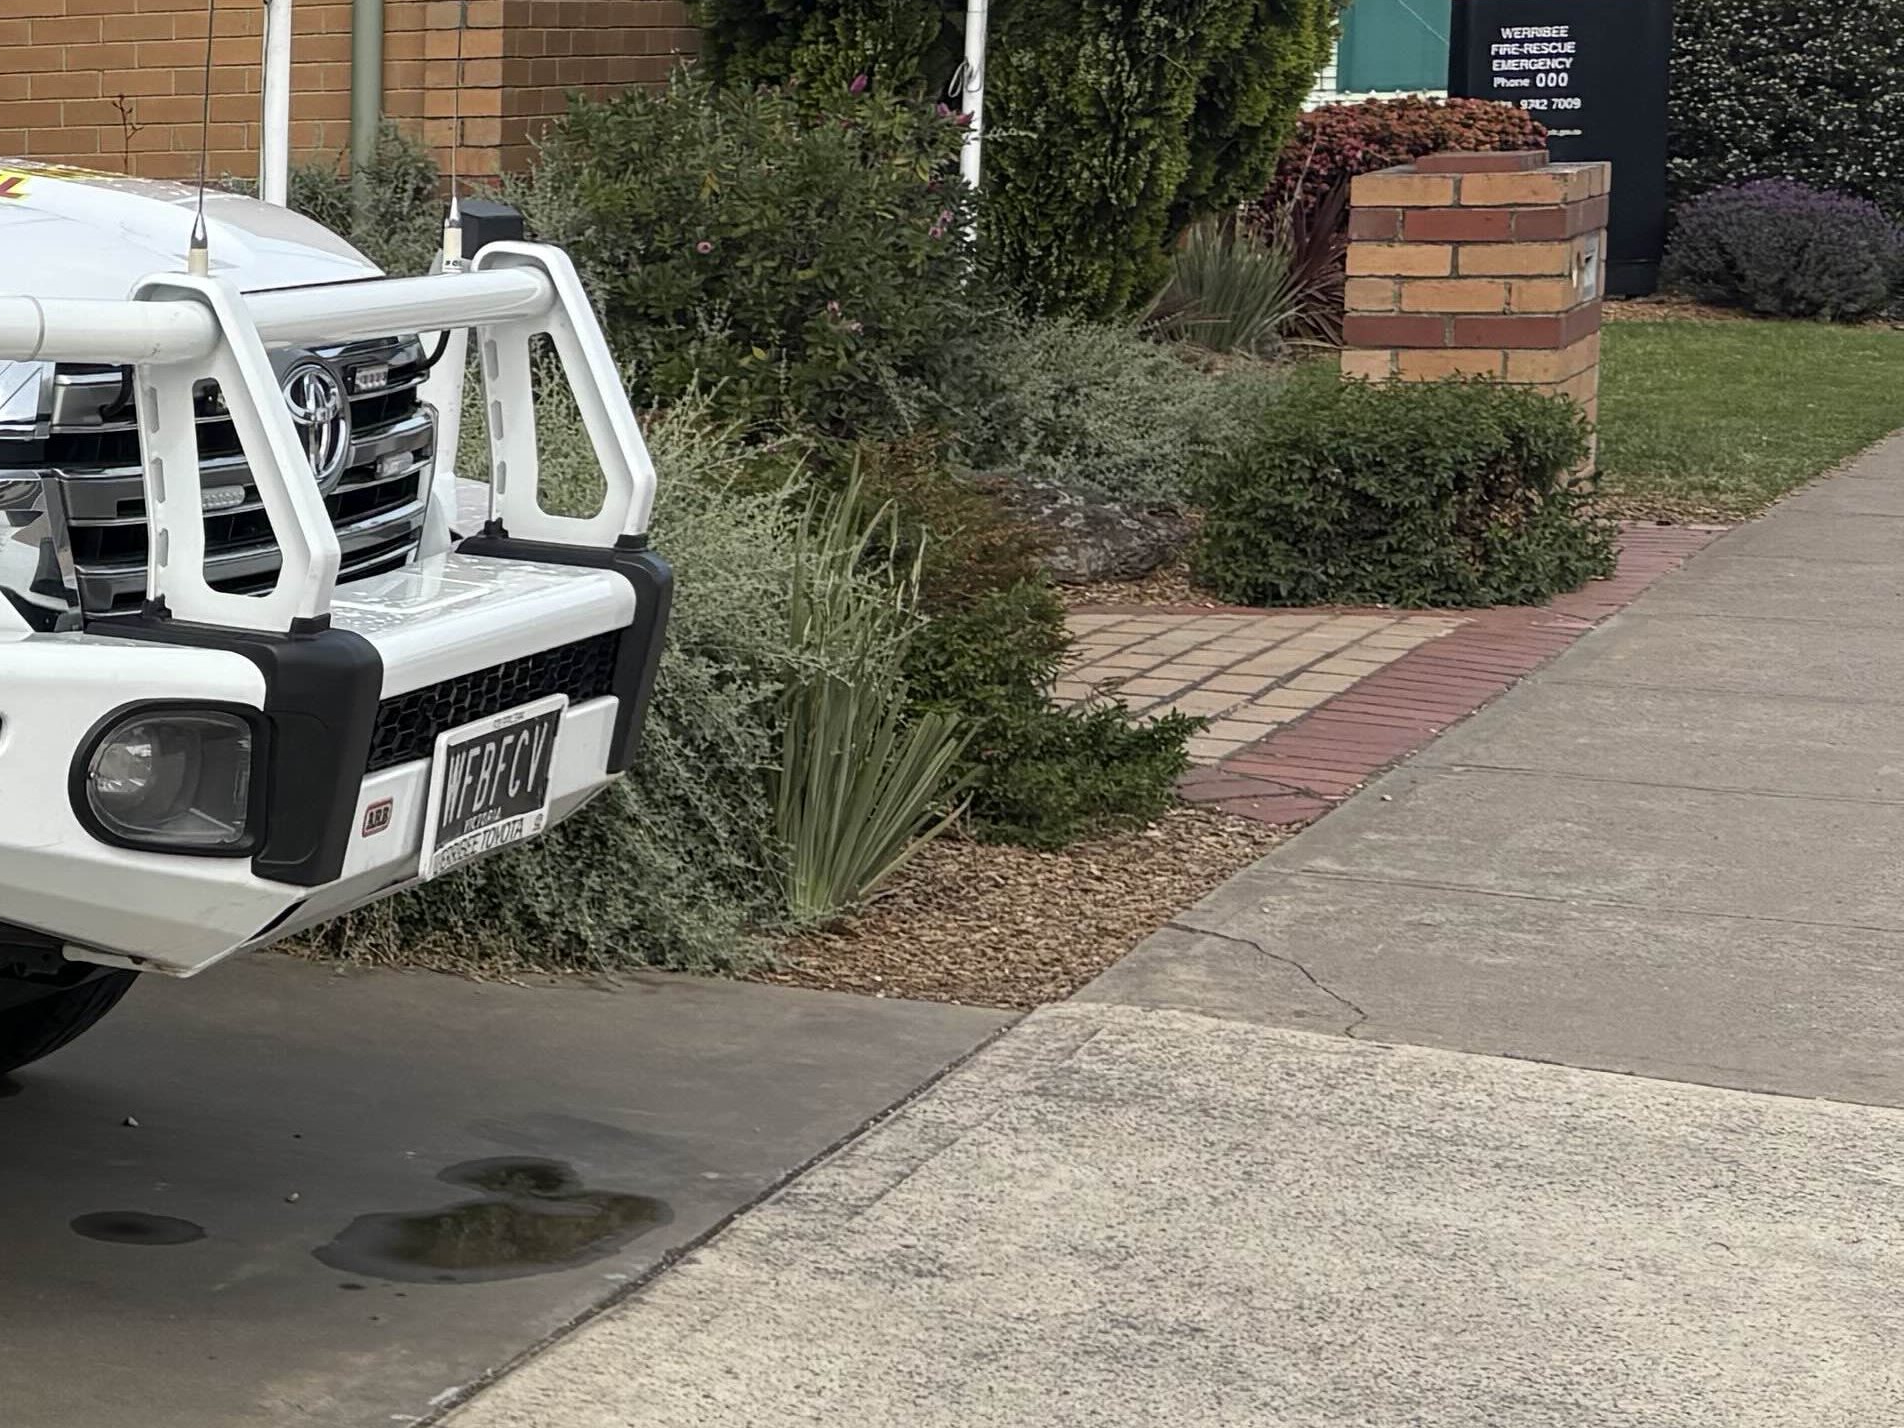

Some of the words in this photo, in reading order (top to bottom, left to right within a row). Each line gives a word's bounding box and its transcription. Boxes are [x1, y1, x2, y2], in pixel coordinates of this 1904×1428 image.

[1500, 26, 1569, 39] WERRIBEE
[1491, 41, 1576, 56] FIRE-RESCUE
[1492, 57, 1573, 71] EMERGENCY
[1493, 77, 1530, 88] Phone
[1535, 72, 1568, 88] 000
[1551, 97, 1582, 110] 7009
[442, 722, 548, 828] WFBFCV
[365, 805, 391, 831] ARB
[480, 818, 524, 851] TOYOTA
